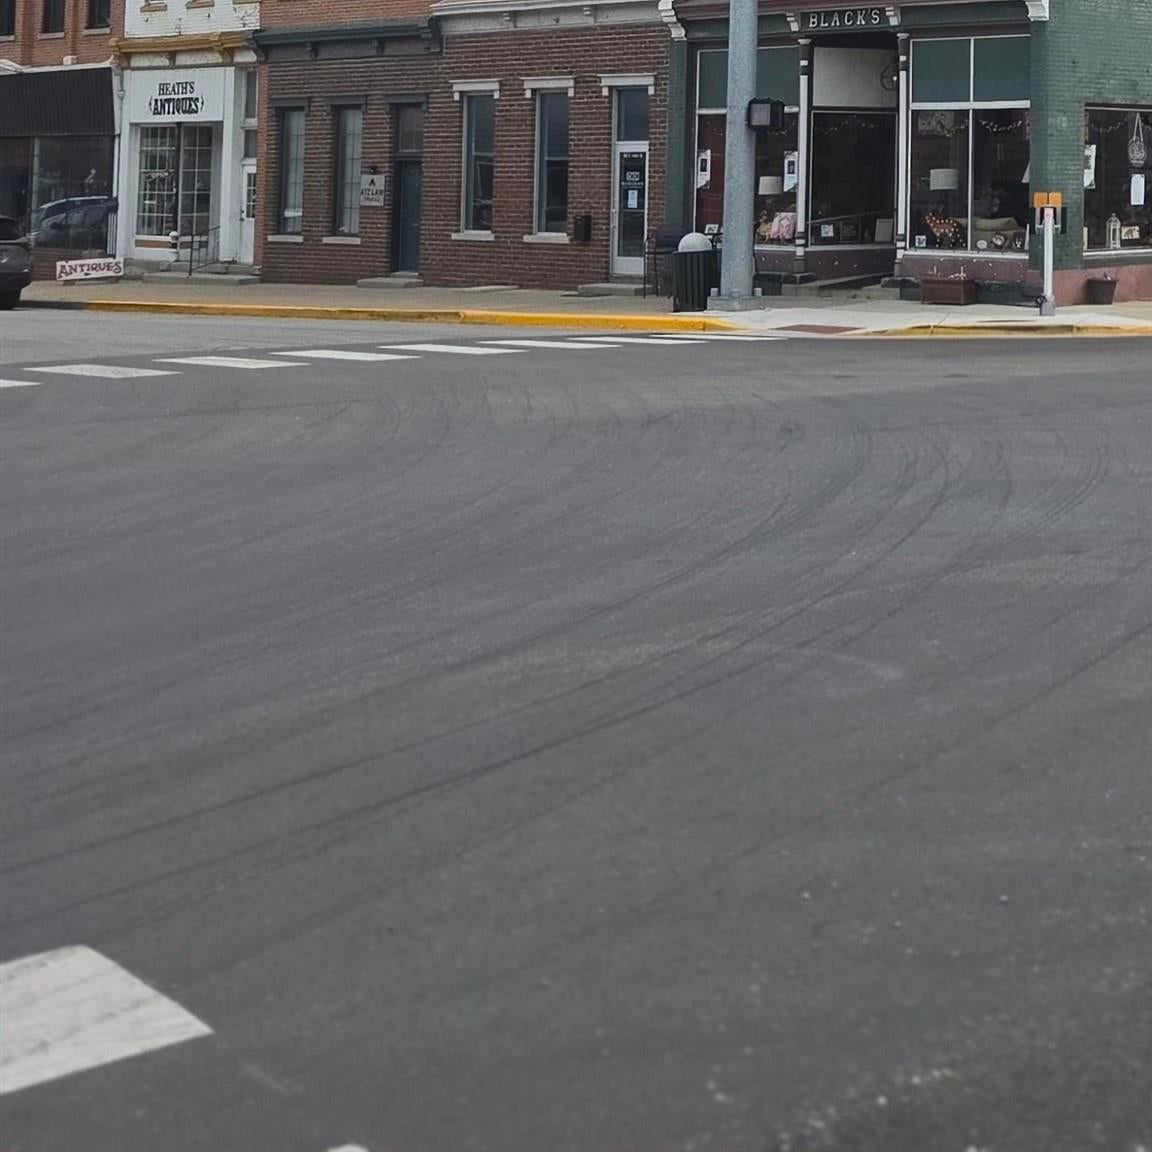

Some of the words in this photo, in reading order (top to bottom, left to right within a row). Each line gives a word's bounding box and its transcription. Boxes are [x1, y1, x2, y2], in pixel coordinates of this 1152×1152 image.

[809, 9, 880, 28] BLACK'S
[153, 97, 200, 115] ANTIQUES
[58, 261, 121, 279] ANTIQUES
